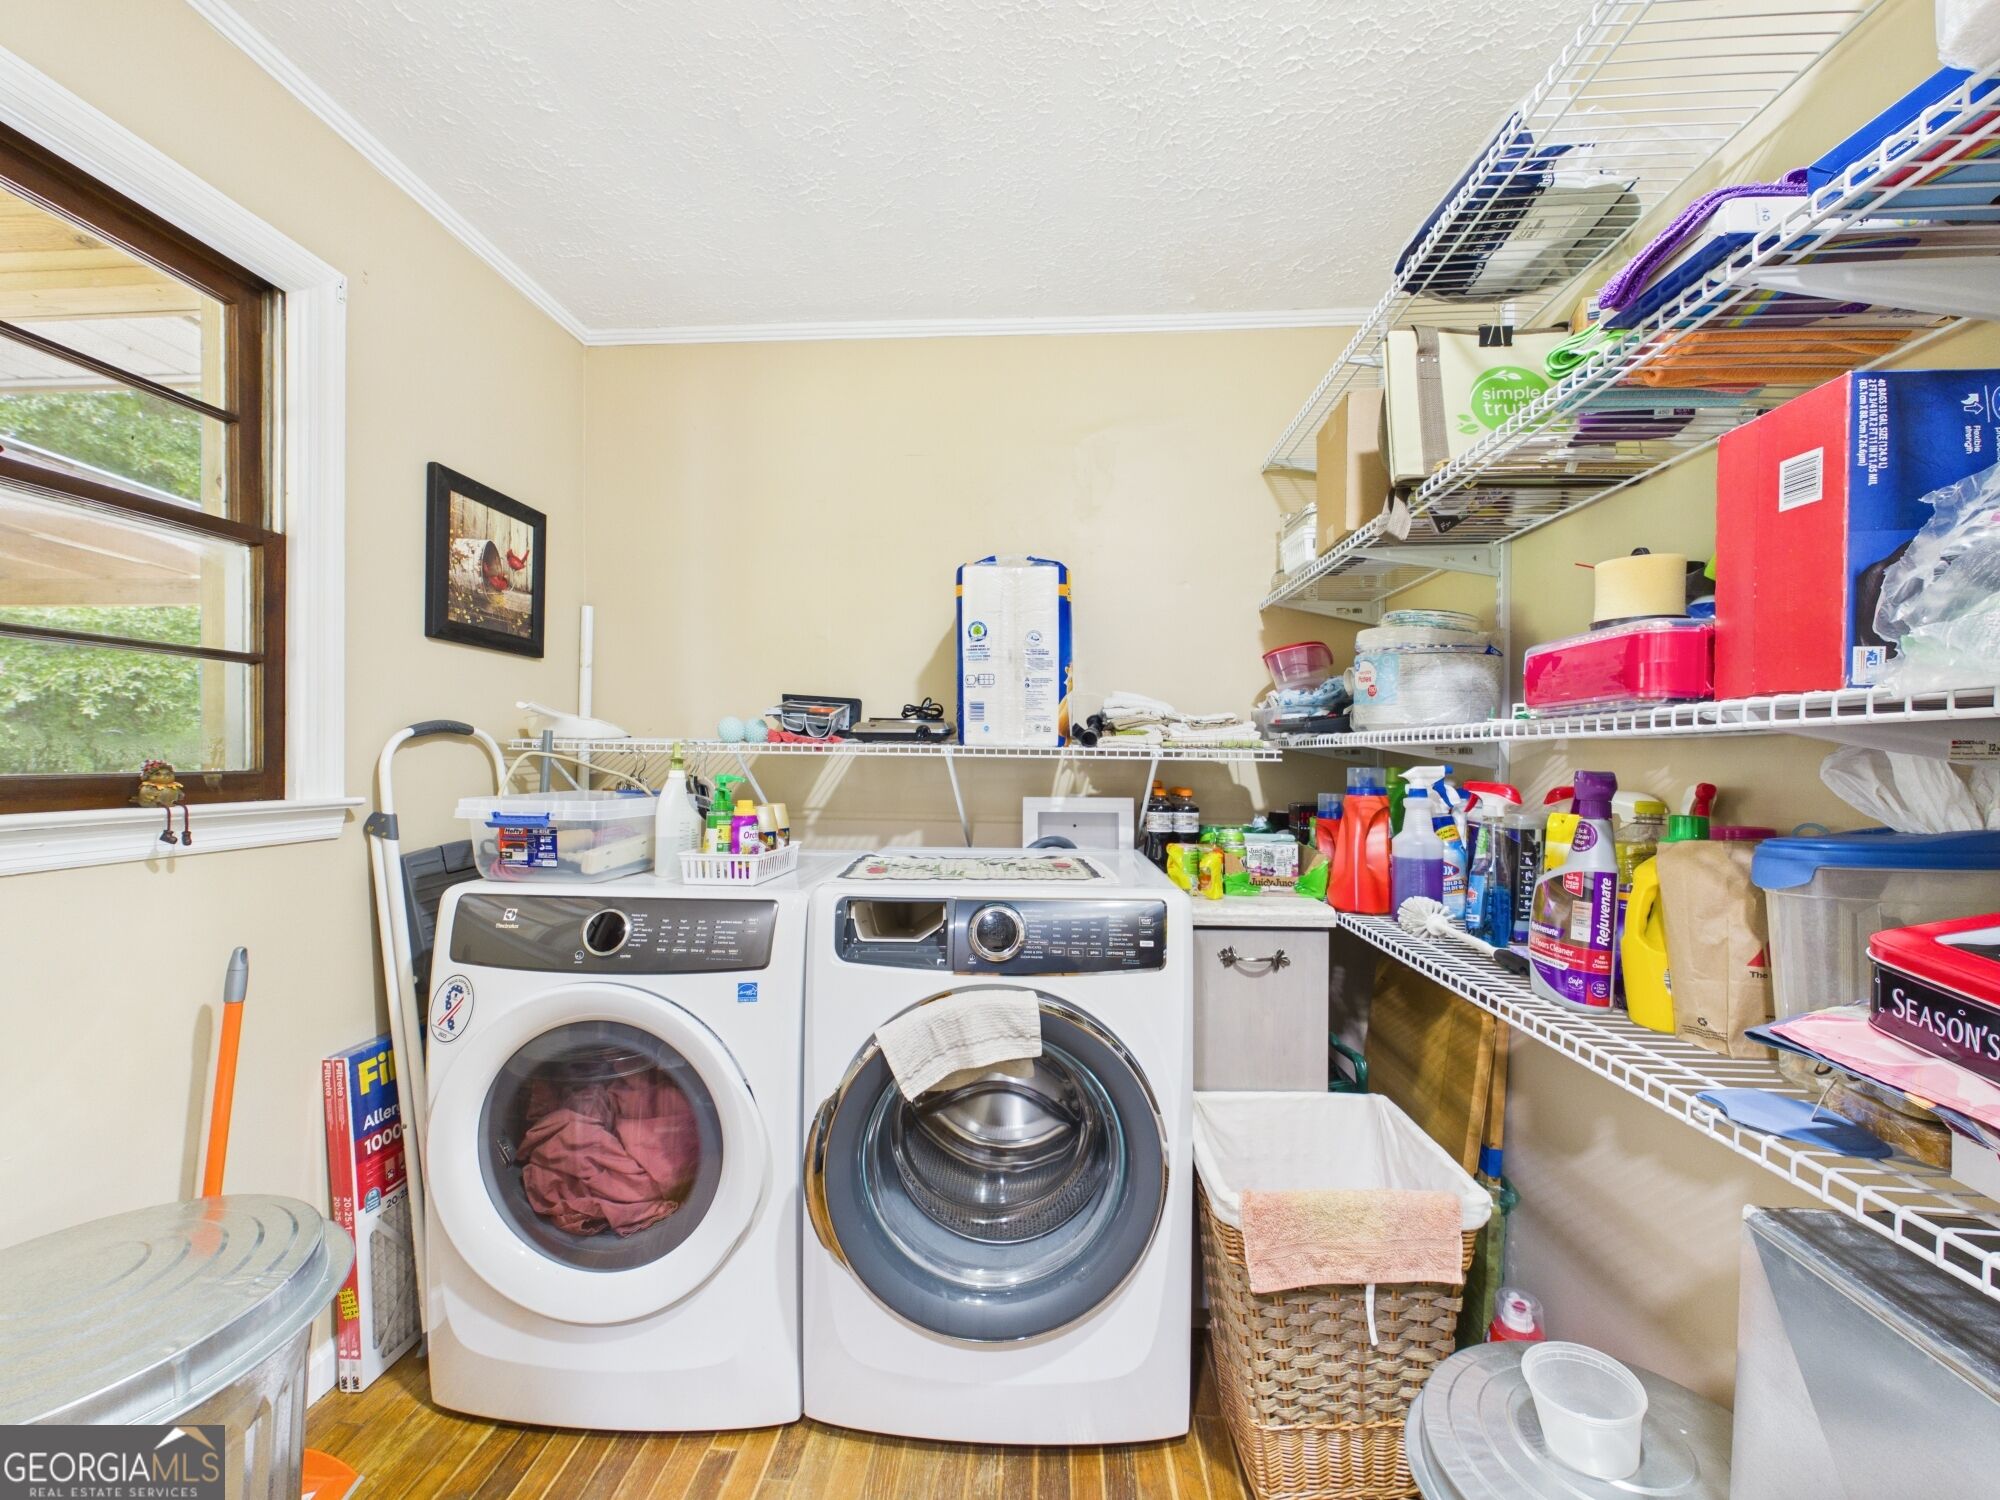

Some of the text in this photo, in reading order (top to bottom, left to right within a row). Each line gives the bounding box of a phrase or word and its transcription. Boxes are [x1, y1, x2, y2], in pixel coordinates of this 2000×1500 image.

[1482, 386, 1541, 401] simple
[1878, 388, 1887, 404] BAGS
[1483, 400, 1533, 416] trut
[1879, 414, 1887, 426] GAL
[1879, 427, 1888, 440] SIZE
[1597, 878, 1612, 946] Rejuvenate
[1550, 942, 1574, 956] Cleaner
[1892, 988, 2000, 1061] SEASON'S
[336, 1062, 344, 1096] Filtrete
[364, 1124, 402, 1154] 1000
